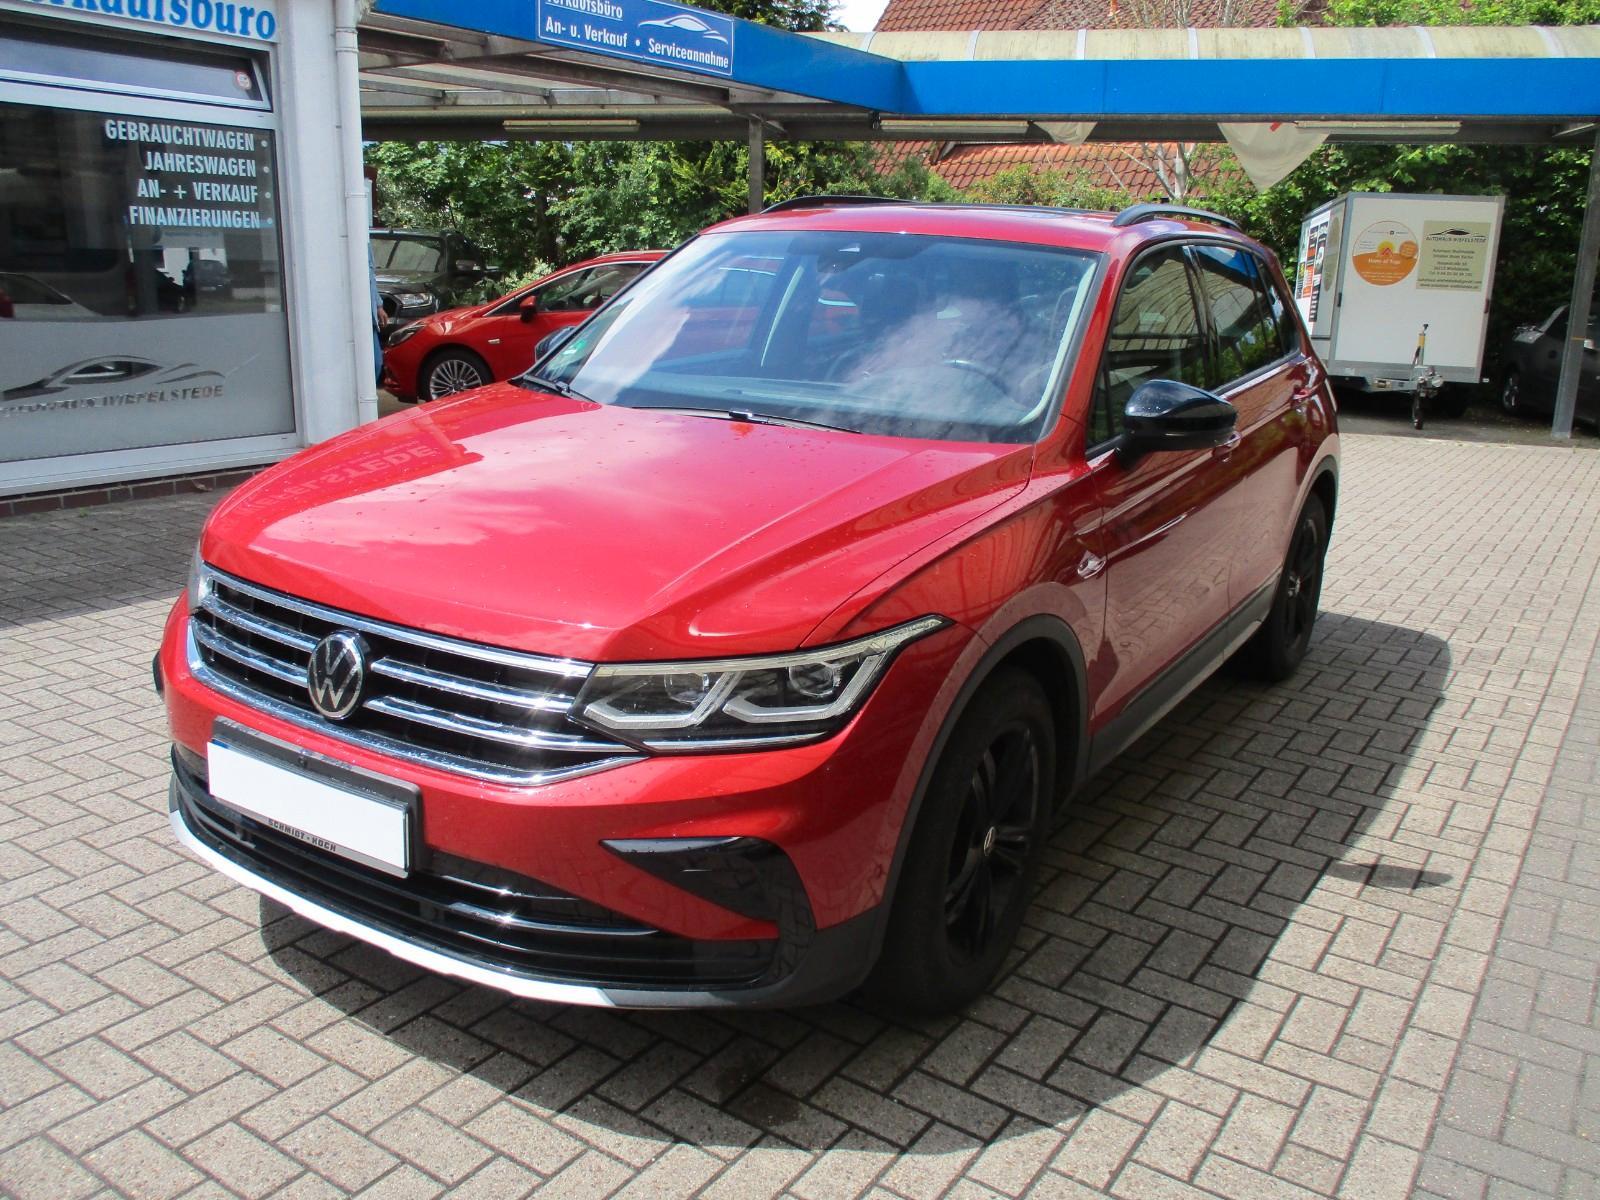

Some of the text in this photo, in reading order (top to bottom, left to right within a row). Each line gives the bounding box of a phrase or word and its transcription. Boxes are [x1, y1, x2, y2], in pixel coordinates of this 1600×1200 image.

[545, 16, 729, 68] An- u. Verkauf Serviceannahme
[104, 119, 255, 152] GEBRAUCHTWAGEN
[144, 151, 257, 178] JAHRESWAGEN
[137, 178, 259, 203] AN- + VERKAUF
[129, 206, 261, 229] FINANZIERUNGEN
[268, 817, 337, 852] SCHMIDT KOCH
